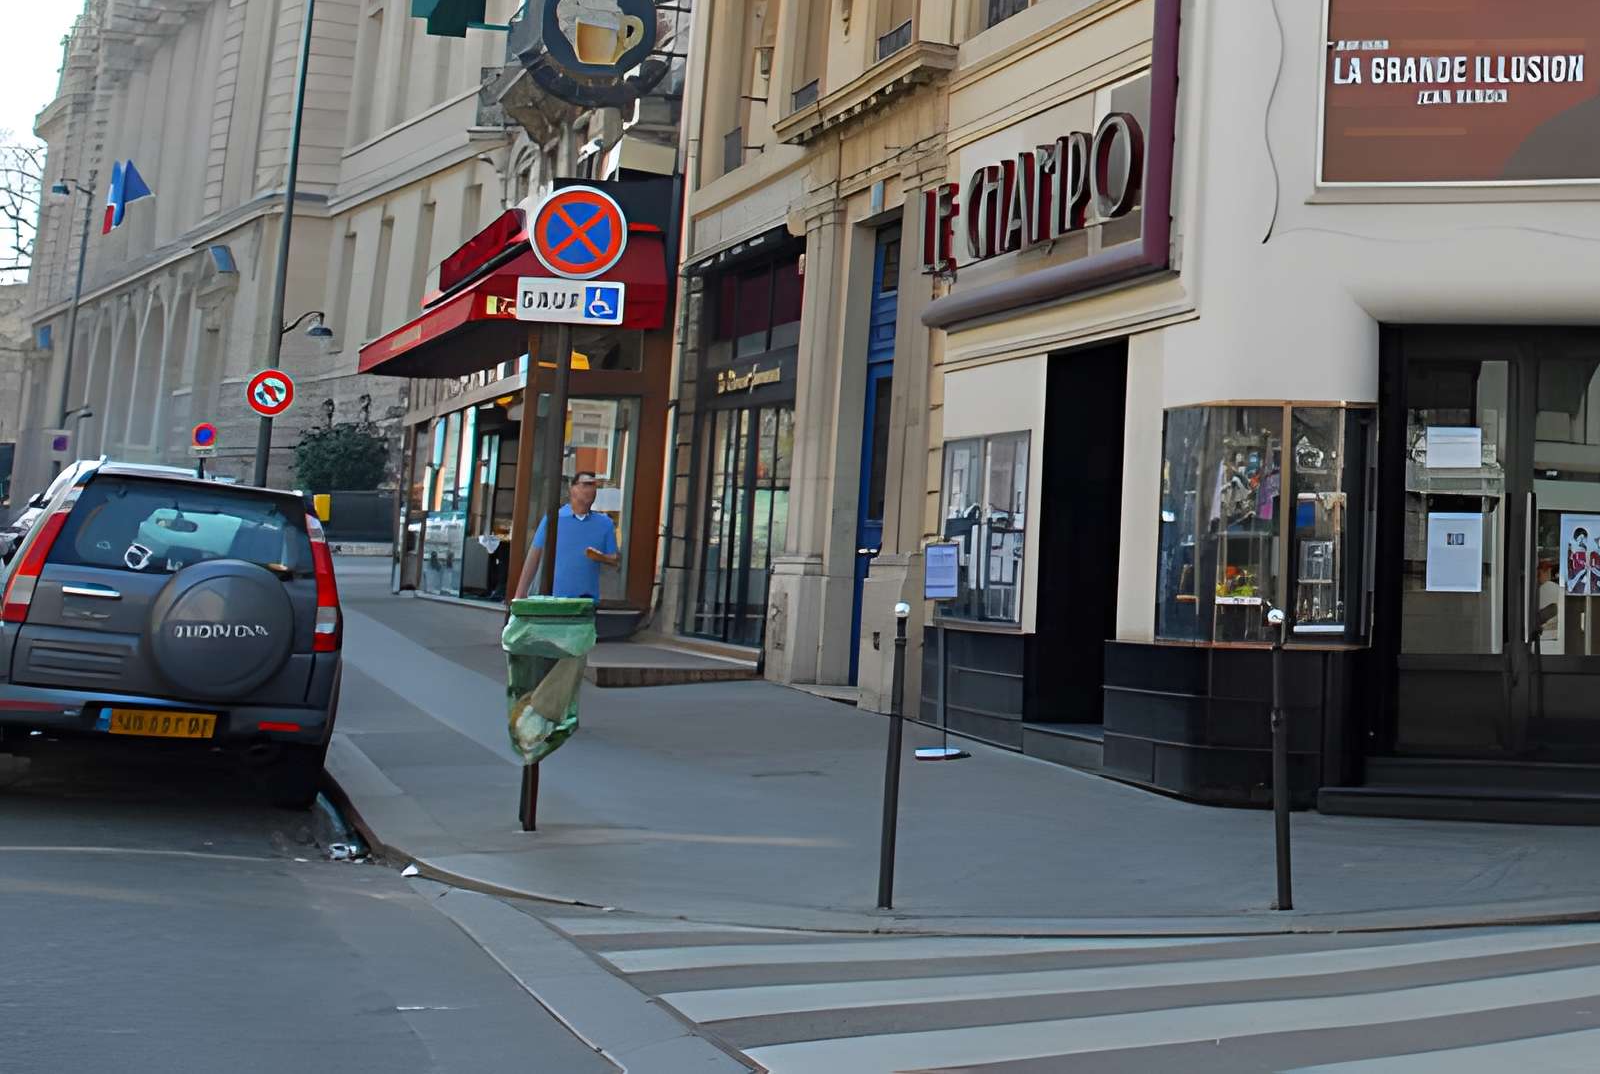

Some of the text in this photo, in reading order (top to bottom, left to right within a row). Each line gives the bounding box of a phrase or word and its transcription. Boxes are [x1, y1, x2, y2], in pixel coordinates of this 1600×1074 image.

[1333, 54, 1584, 84] LA GRANDE ILLUSION
[921, 112, 1145, 274] LE CHAMPO
